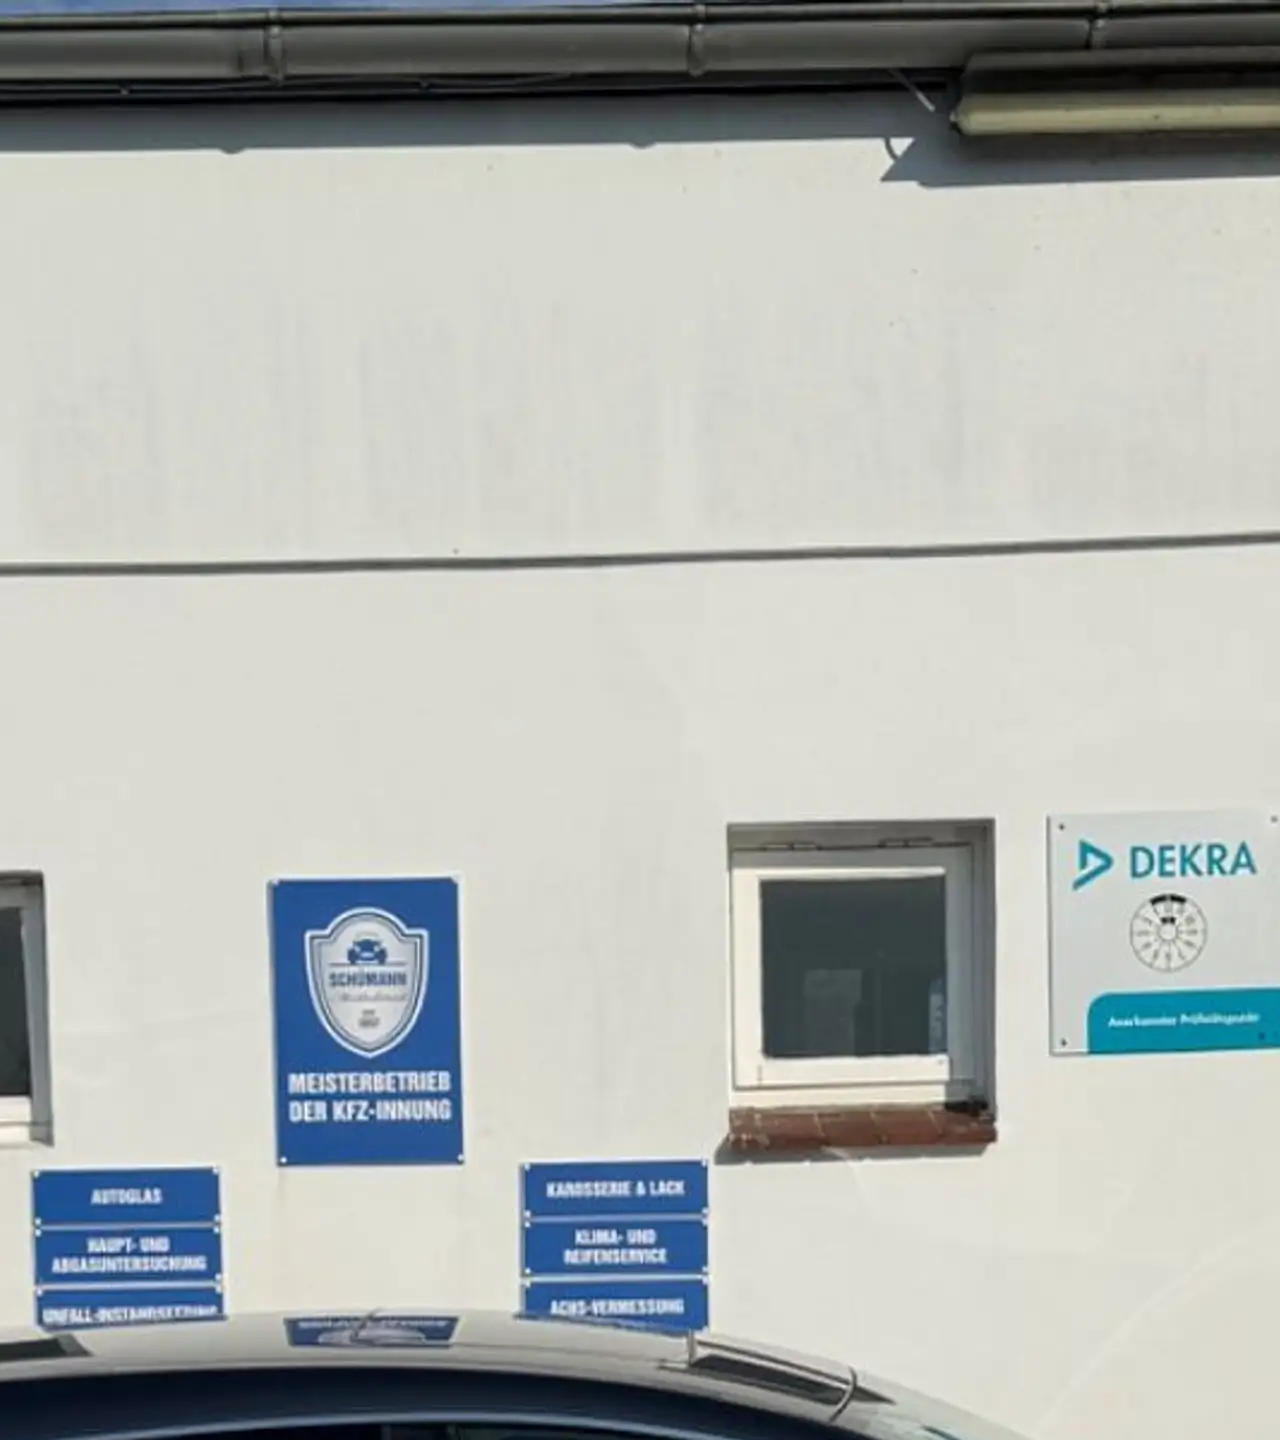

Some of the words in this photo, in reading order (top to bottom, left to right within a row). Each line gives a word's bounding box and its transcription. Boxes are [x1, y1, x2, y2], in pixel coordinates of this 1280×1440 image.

[1130, 840, 1258, 879] DEKRA
[288, 1070, 452, 1094] MEISTERBETRIEB
[288, 1100, 328, 1122] DER
[332, 1099, 452, 1122] KFZ-INNUNG
[91, 1187, 163, 1204] AUTOGLAS
[546, 1181, 631, 1198] KAROSSERIE
[650, 1180, 685, 1196] LACK
[87, 1237, 137, 1253] HAUPT-
[139, 1237, 170, 1252] UND
[575, 1229, 623, 1245] KLIMA-
[627, 1229, 657, 1244] UND
[52, 1255, 207, 1274] ABGASUNTERSUCHUNG
[563, 1249, 667, 1265] REIFENSERVICE
[551, 1298, 685, 1316] ACHS-VERMESSUNG
